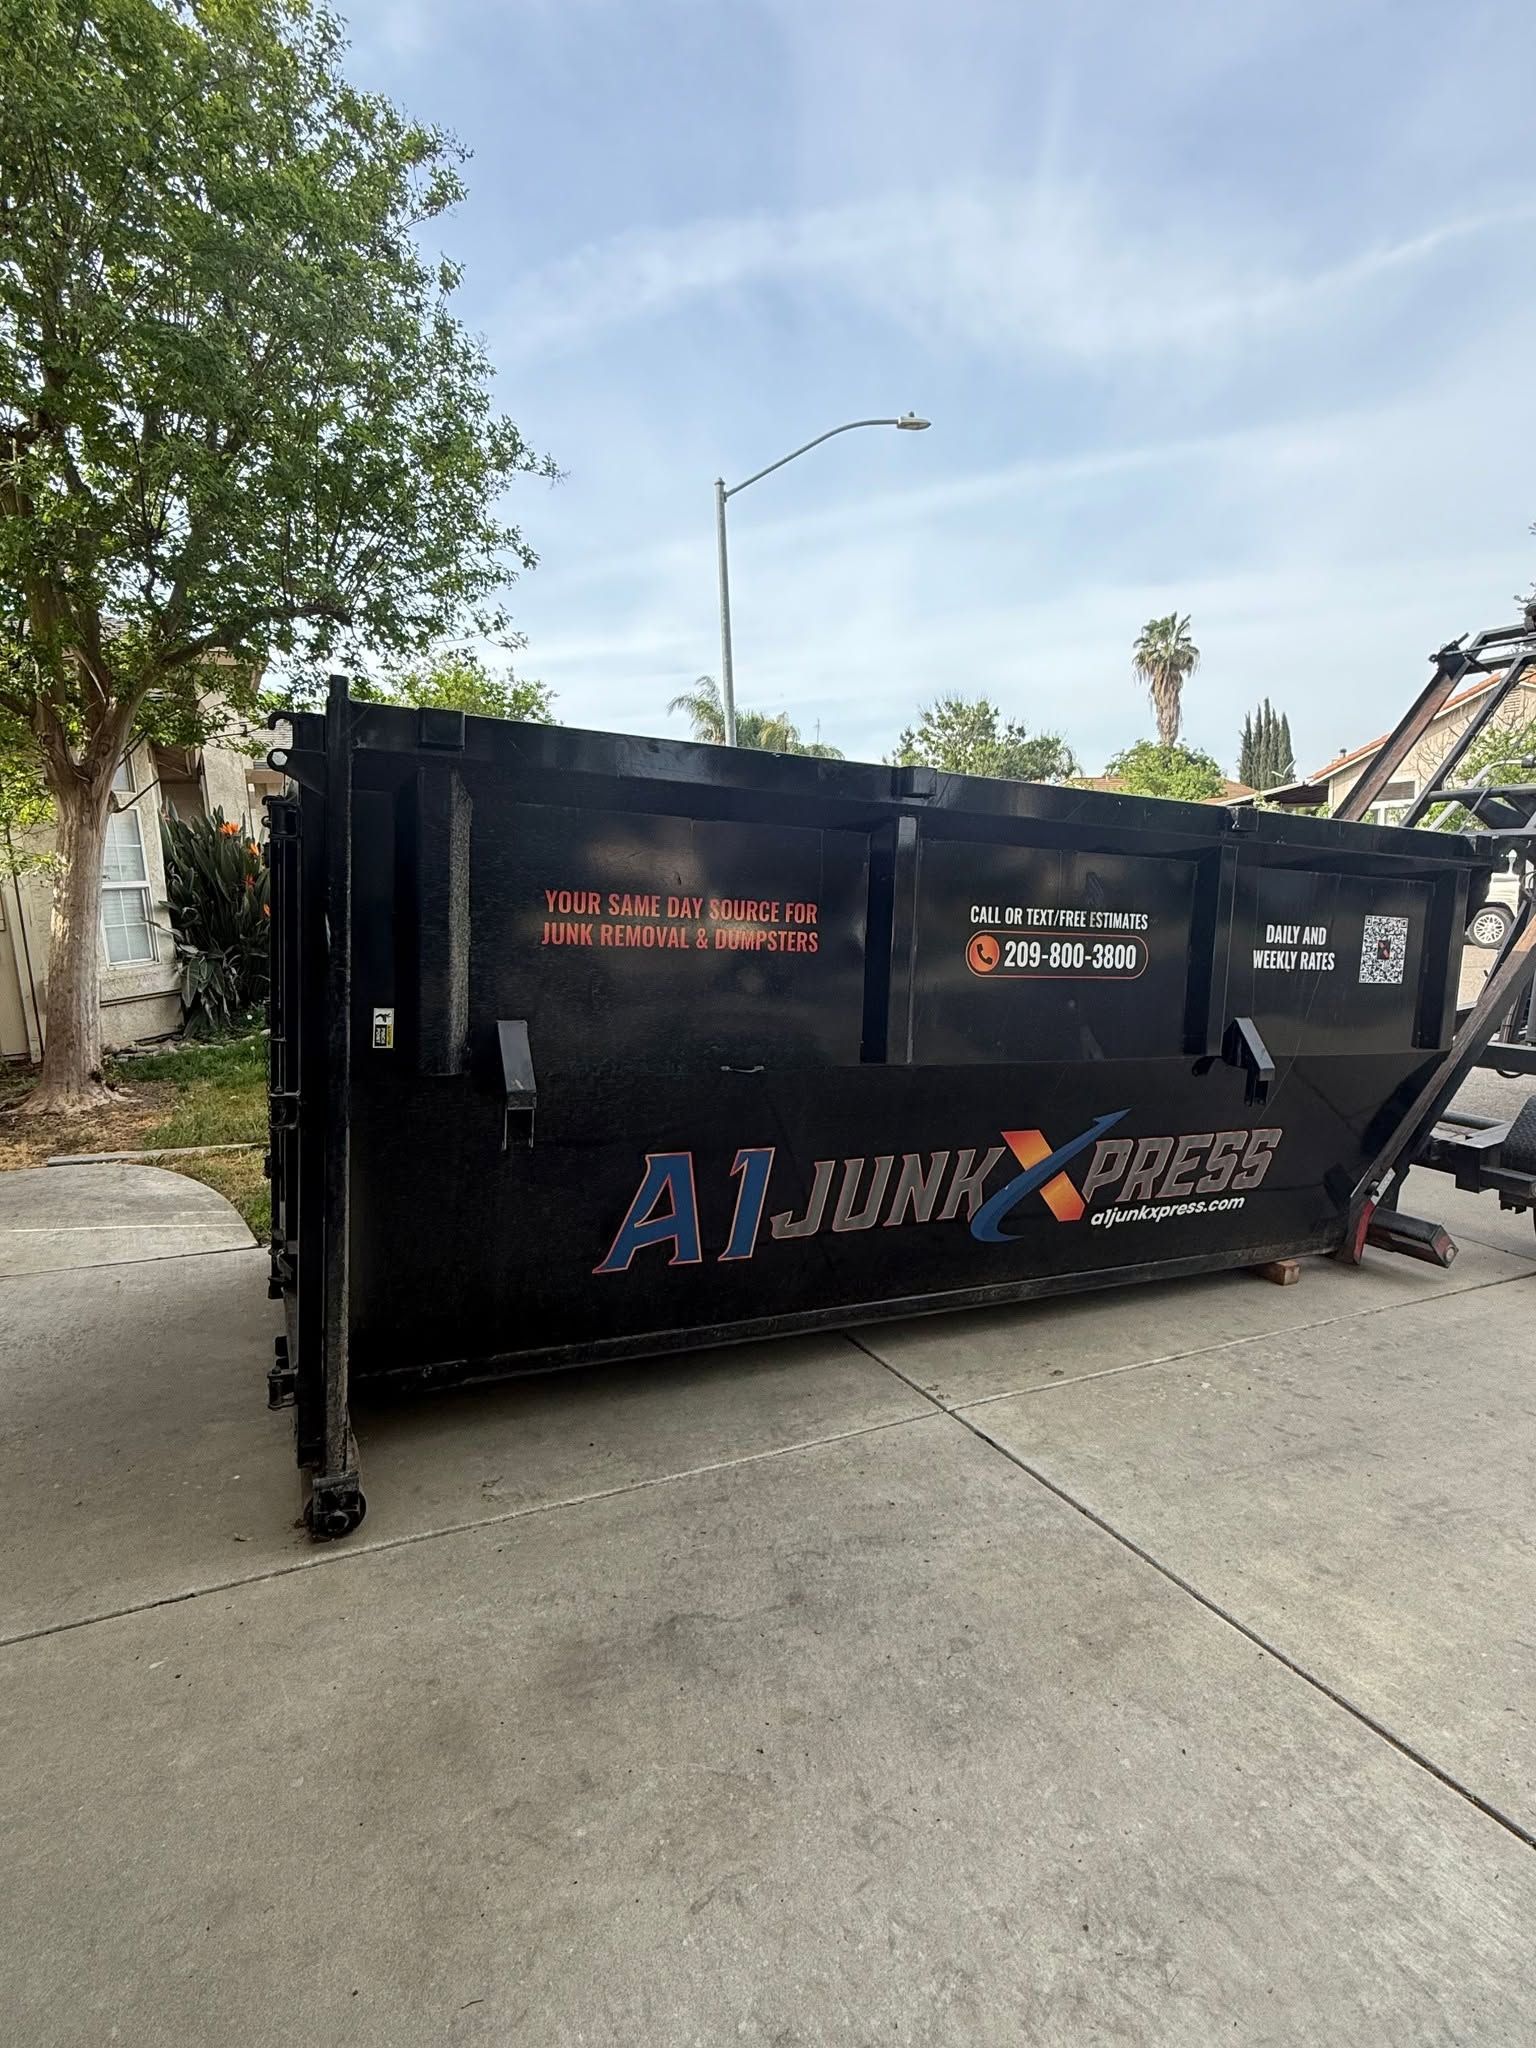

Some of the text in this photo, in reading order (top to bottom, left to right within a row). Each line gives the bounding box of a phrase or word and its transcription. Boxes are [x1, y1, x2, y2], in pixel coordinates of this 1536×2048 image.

[545, 889, 818, 925] YOUR SAME DAY SOURCE FOR
[970, 905, 1149, 930] CALL OR TEXT/FREE ESTIMATES
[541, 921, 819, 953] JUNK REMOVAL & DUMPSTERS
[1265, 924, 1327, 946] DAILY AND
[1003, 940, 1137, 970] 209-800-3800
[1252, 949, 1335, 971] WEEKLY RATES
[592, 1147, 776, 1274] A1
